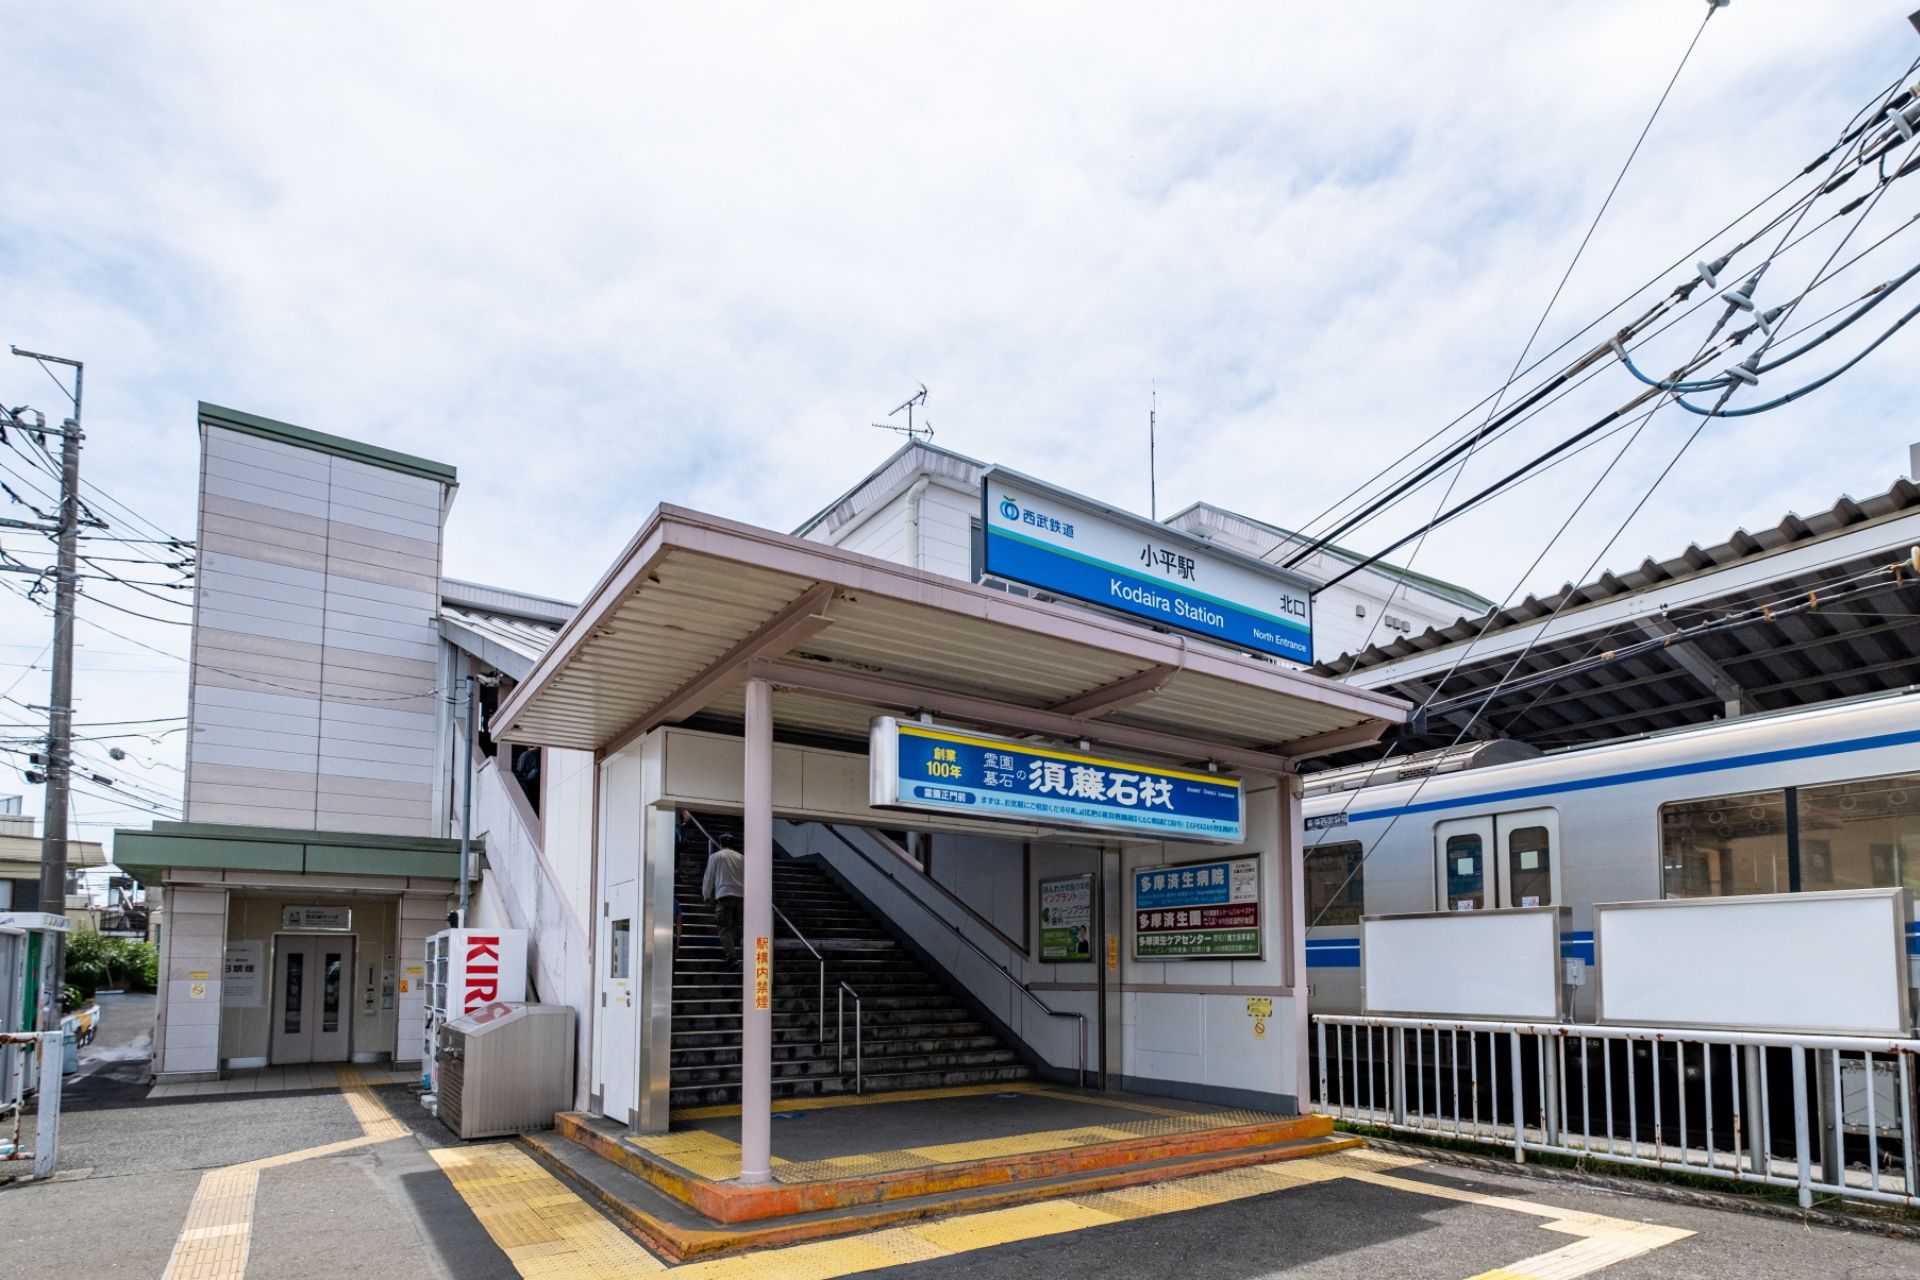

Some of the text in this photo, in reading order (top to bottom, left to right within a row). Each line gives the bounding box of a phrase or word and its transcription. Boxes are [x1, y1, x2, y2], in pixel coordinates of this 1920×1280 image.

[1023, 509, 1074, 538] 西武鉄道
[1140, 544, 1196, 582] 小平駅
[1110, 578, 1224, 628] Kodaira Station
[1280, 593, 1306, 618] 北口
[1253, 628, 1307, 653] North Entrance
[933, 747, 957, 762] 創業
[926, 761, 962, 779] 100年
[1140, 868, 1225, 892] 多摩済生病院
[1044, 892, 1078, 903] インプラント
[1139, 910, 1202, 929] 多摩済生園
[1138, 934, 1212, 947] 多摩済生ケアセンター
[756, 936, 769, 1009] 駅構内禁煙
